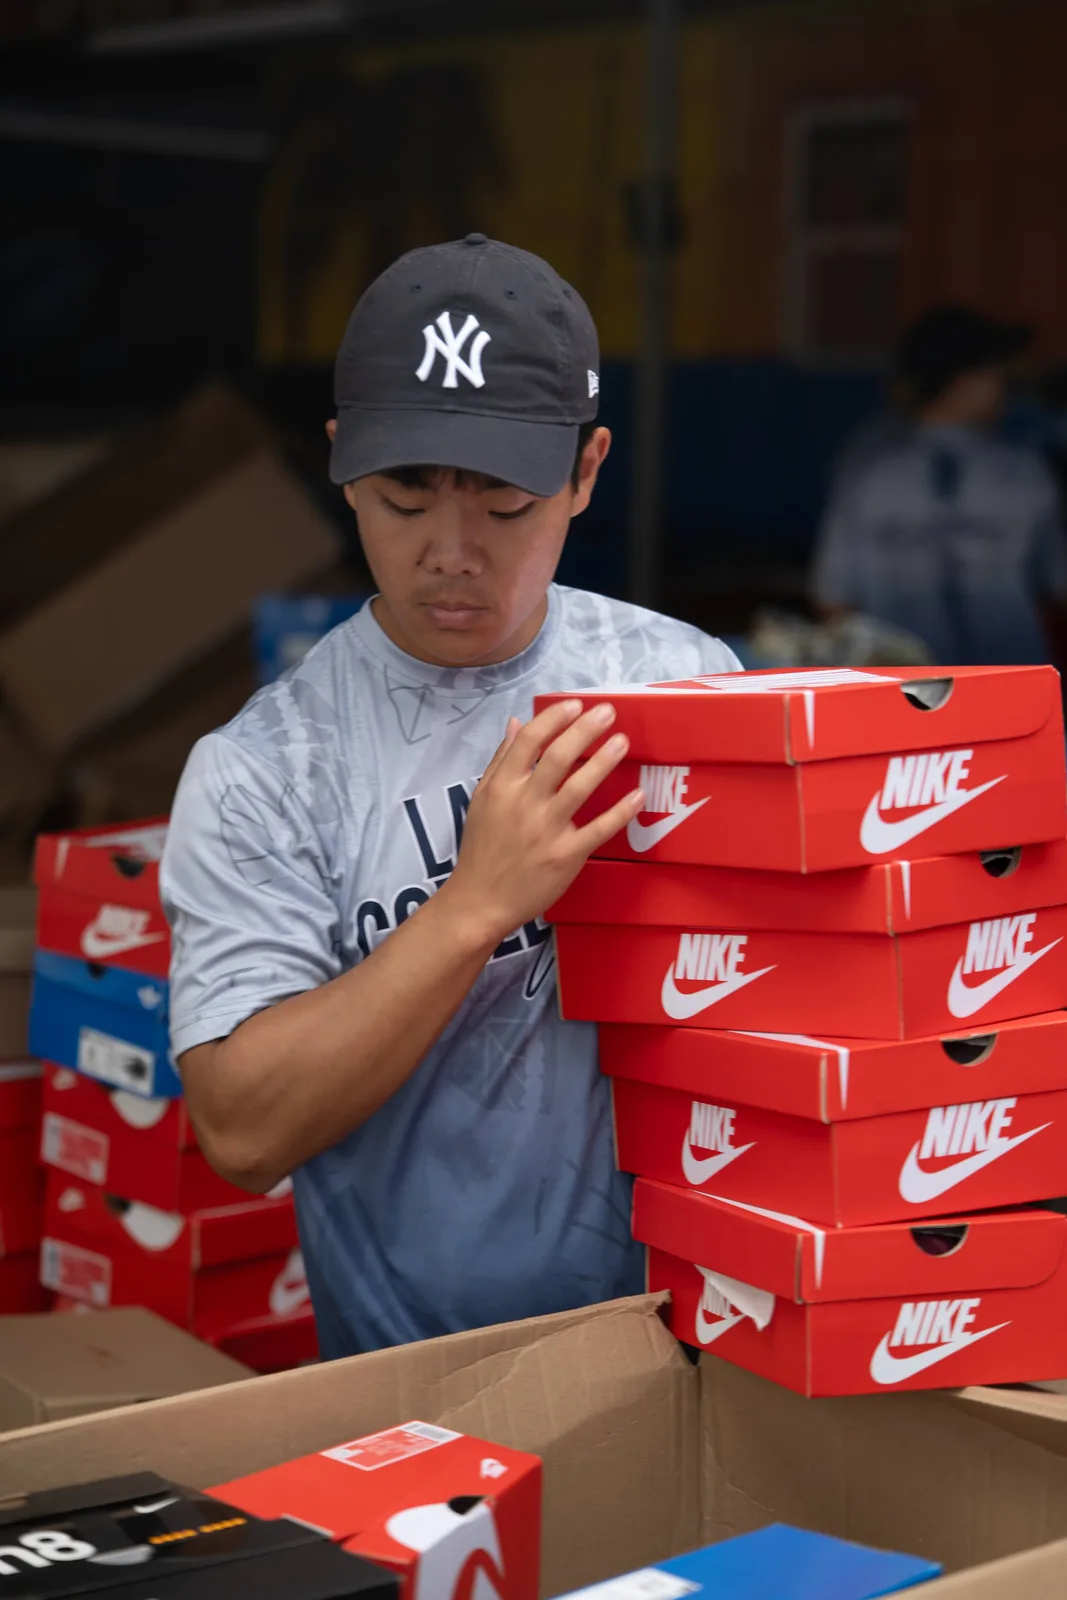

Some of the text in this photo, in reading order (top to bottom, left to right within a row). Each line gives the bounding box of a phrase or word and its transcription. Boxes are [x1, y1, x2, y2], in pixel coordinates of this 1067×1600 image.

[638, 765, 690, 814] NIKE
[880, 749, 973, 810] NIKE
[675, 933, 748, 981] NIKE
[962, 912, 1037, 974] NIKE
[689, 1101, 736, 1153] NIKE
[918, 1097, 1018, 1159] NIKE
[889, 1298, 981, 1347] NIKE
